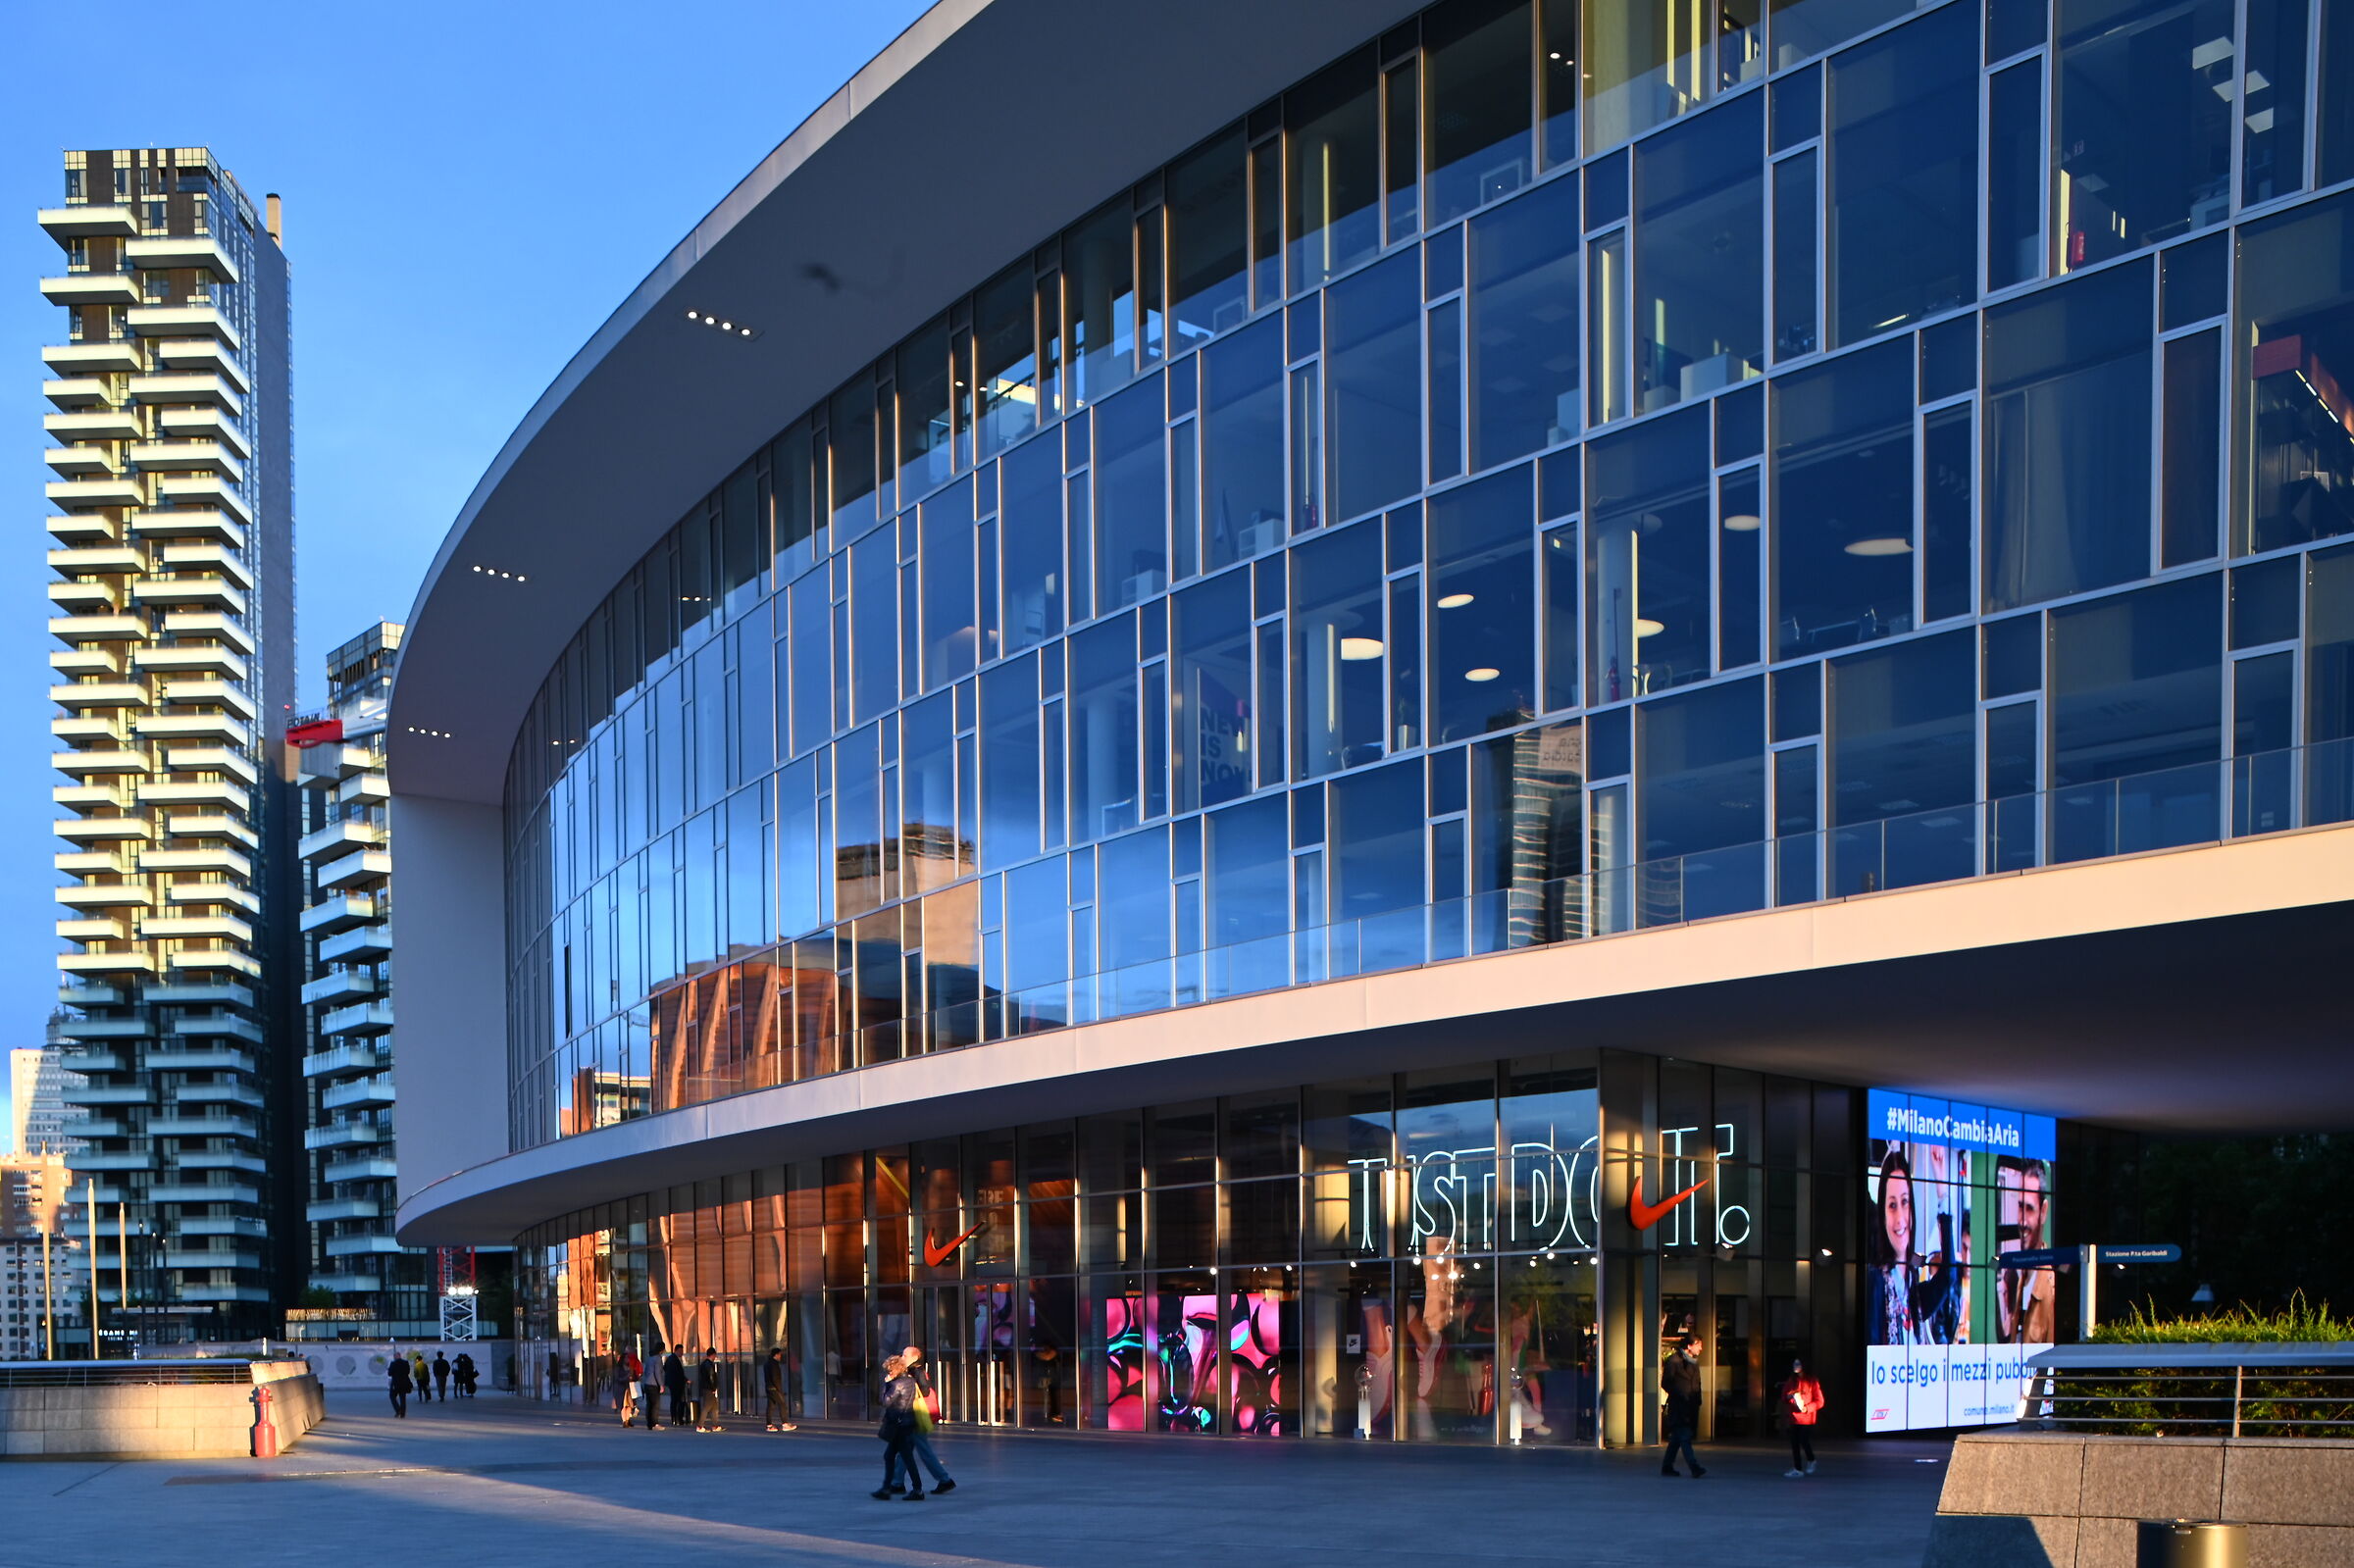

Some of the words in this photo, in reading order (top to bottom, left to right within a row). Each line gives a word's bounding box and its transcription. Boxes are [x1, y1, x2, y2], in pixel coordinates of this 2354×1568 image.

[1201, 733, 1222, 759] IS
[1886, 1106, 2020, 1147] #MilanoCambiaAria
[1890, 1358, 1938, 1388] scelgo
[1942, 1358, 1947, 1382] i
[1951, 1358, 1991, 1382] mezzi
[1963, 1403, 2015, 1417] comune.milano.it
